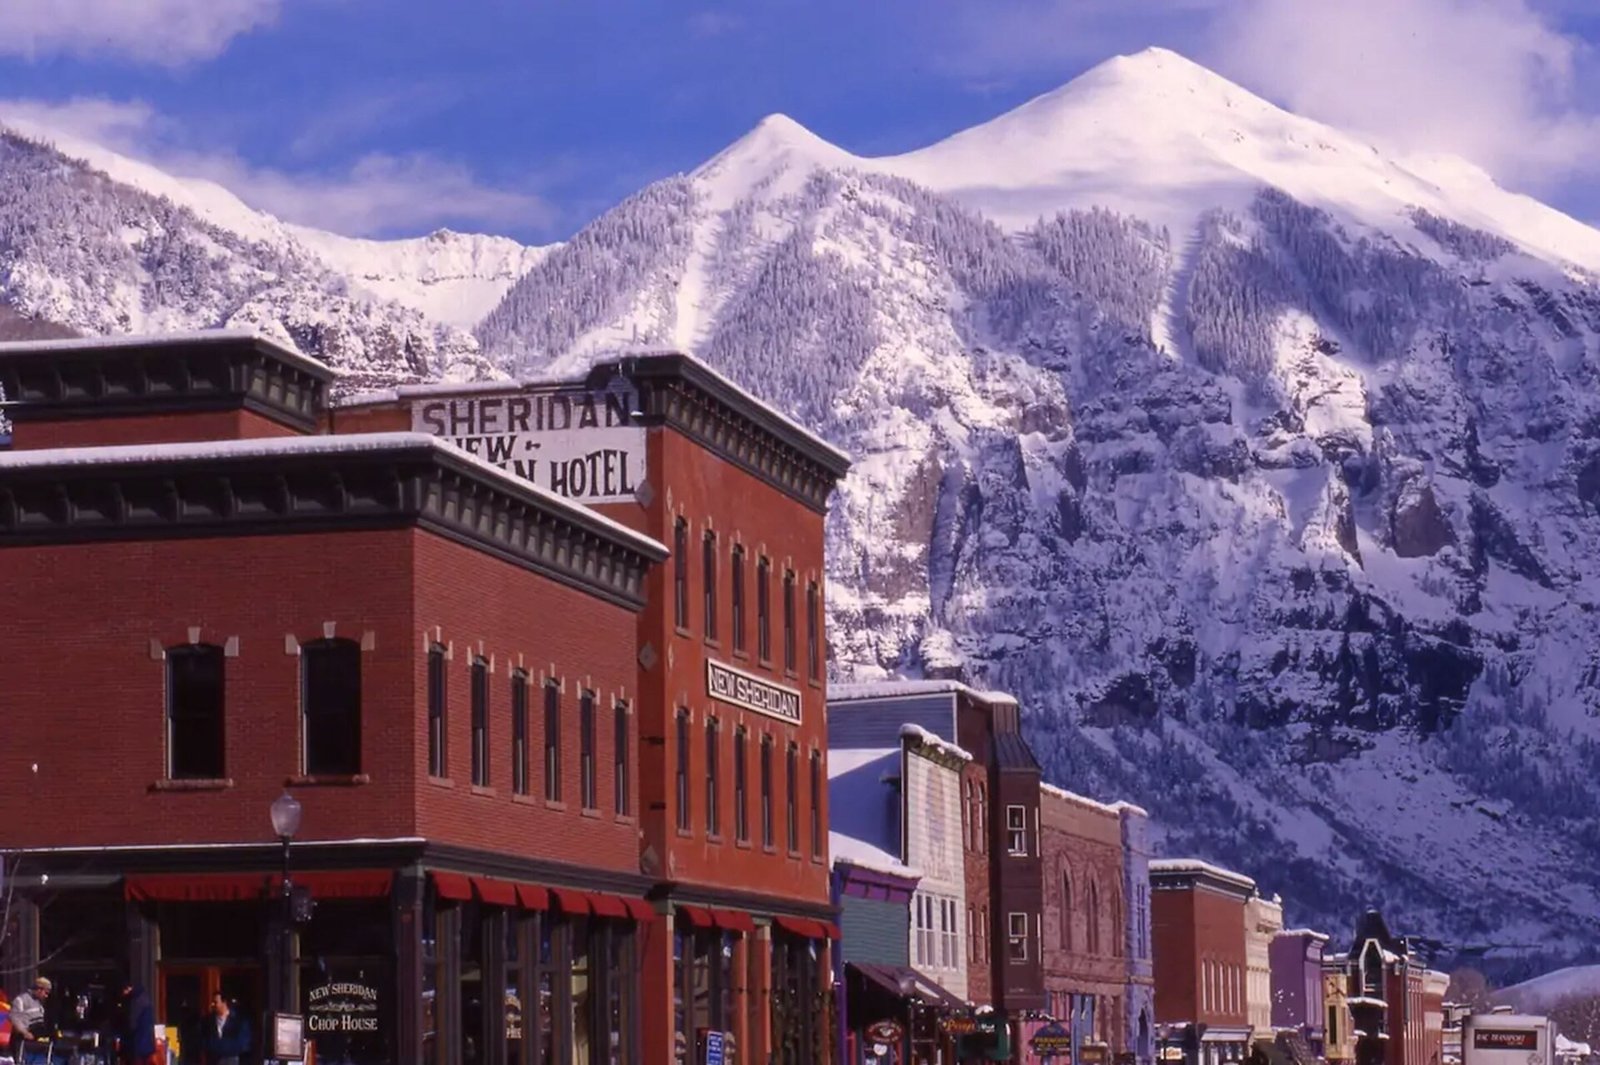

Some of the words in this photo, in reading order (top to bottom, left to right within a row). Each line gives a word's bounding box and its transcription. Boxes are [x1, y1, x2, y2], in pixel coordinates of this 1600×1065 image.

[422, 394, 631, 436] SHERIDAN
[551, 449, 634, 497] HOTEL
[710, 668, 735, 696] NEW
[737, 677, 797, 718] SHERIDAN
[309, 984, 331, 1002] NEW
[331, 983, 377, 1000] SHERIDAN
